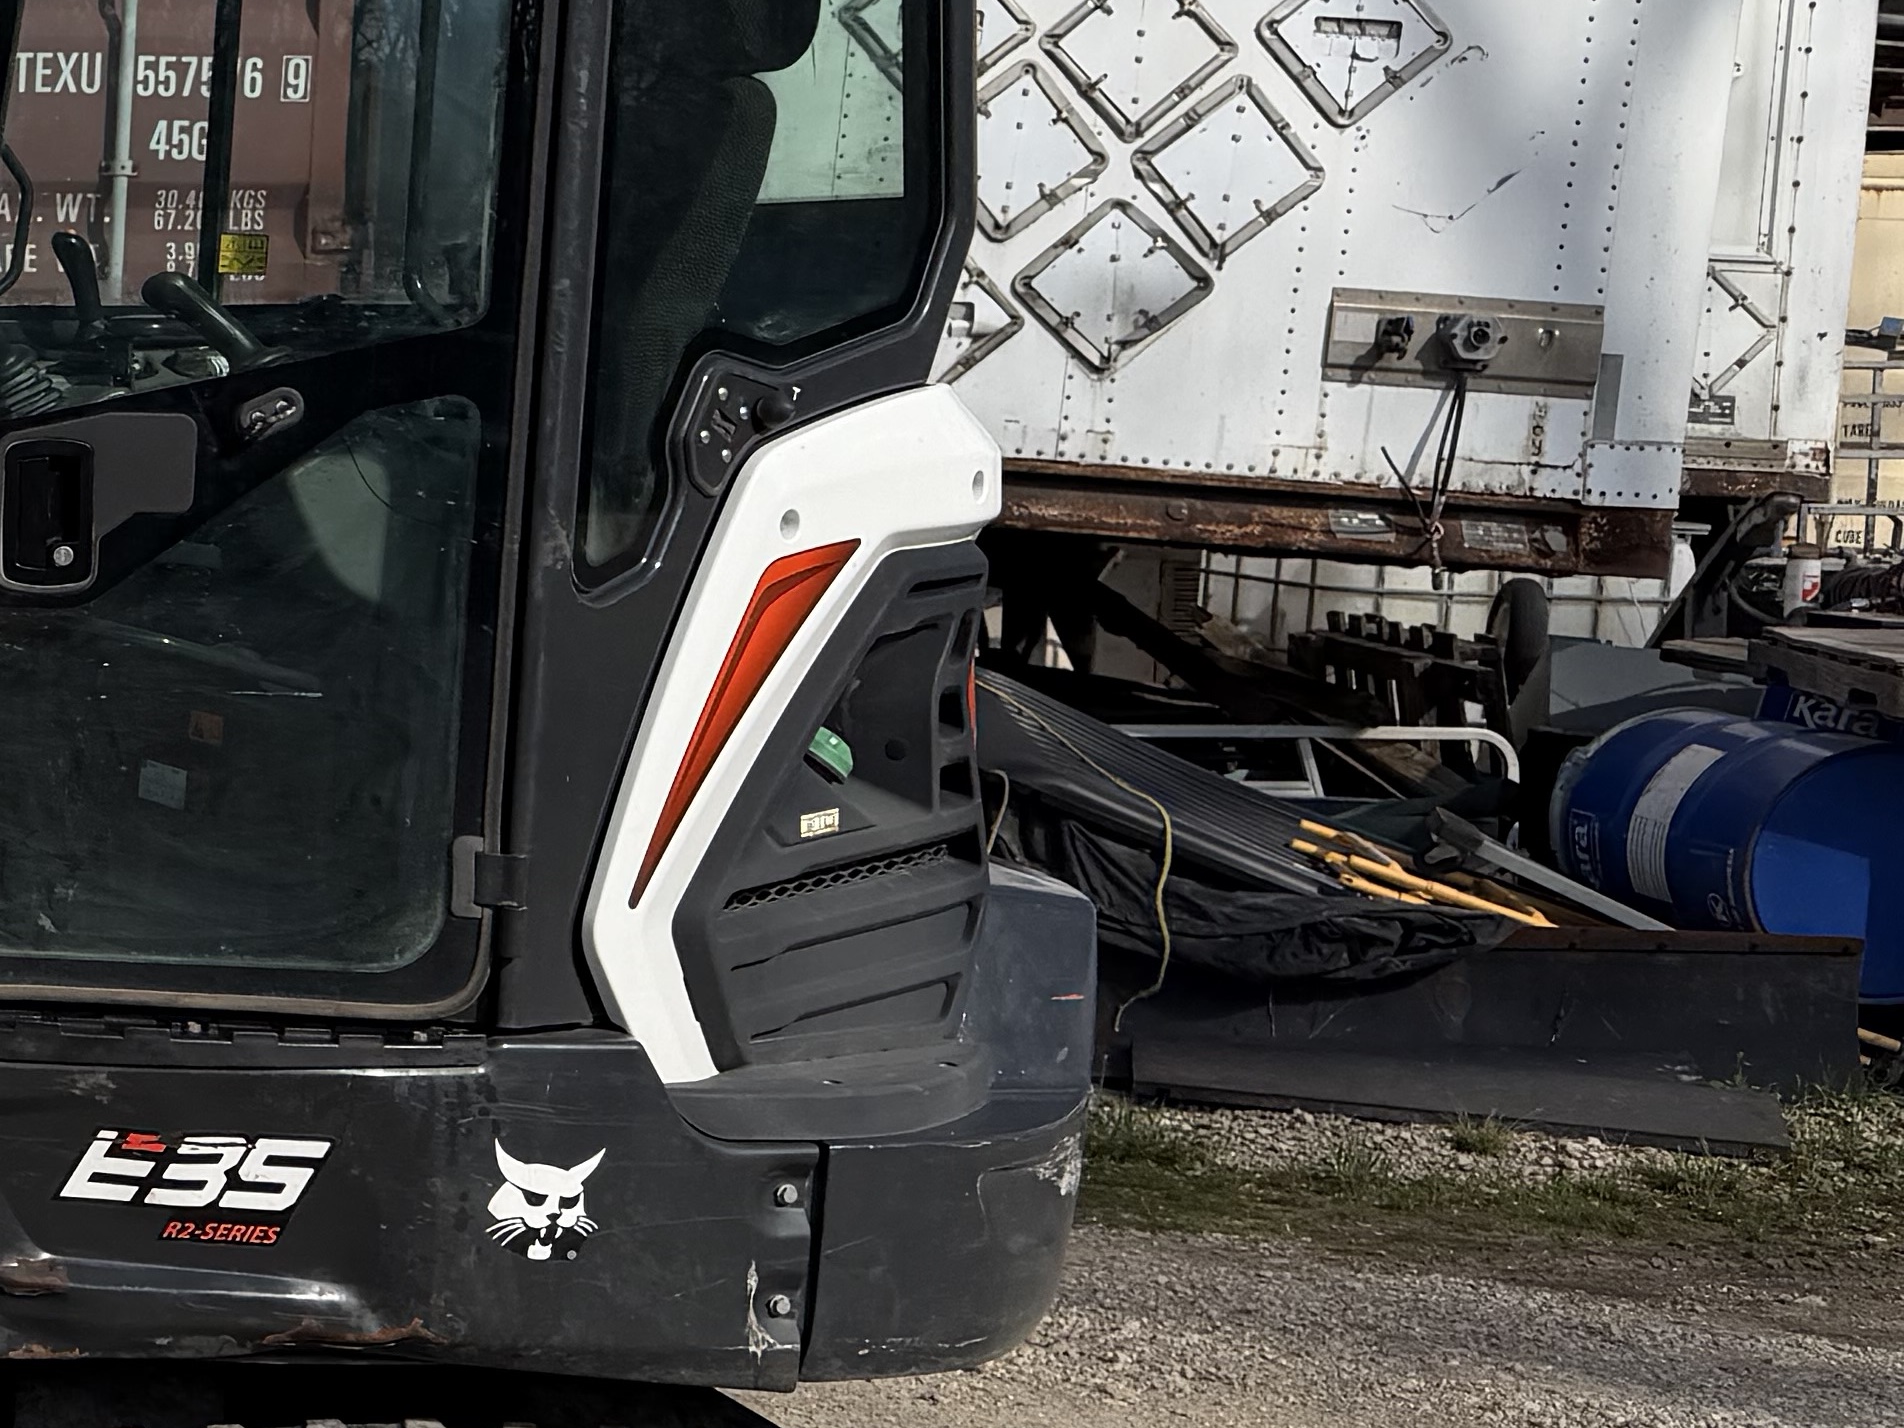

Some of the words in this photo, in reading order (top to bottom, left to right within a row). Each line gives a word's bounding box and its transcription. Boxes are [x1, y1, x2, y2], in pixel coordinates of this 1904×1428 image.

[16, 52, 102, 94] TEXU
[137, 56, 263, 99] 55756
[284, 57, 308, 100] 9
[149, 120, 208, 160] 45G
[230, 189, 267, 209] KGS
[229, 210, 264, 230] LBS
[59, 1129, 332, 1211] E35
[162, 1221, 281, 1244] R2-SERIES
